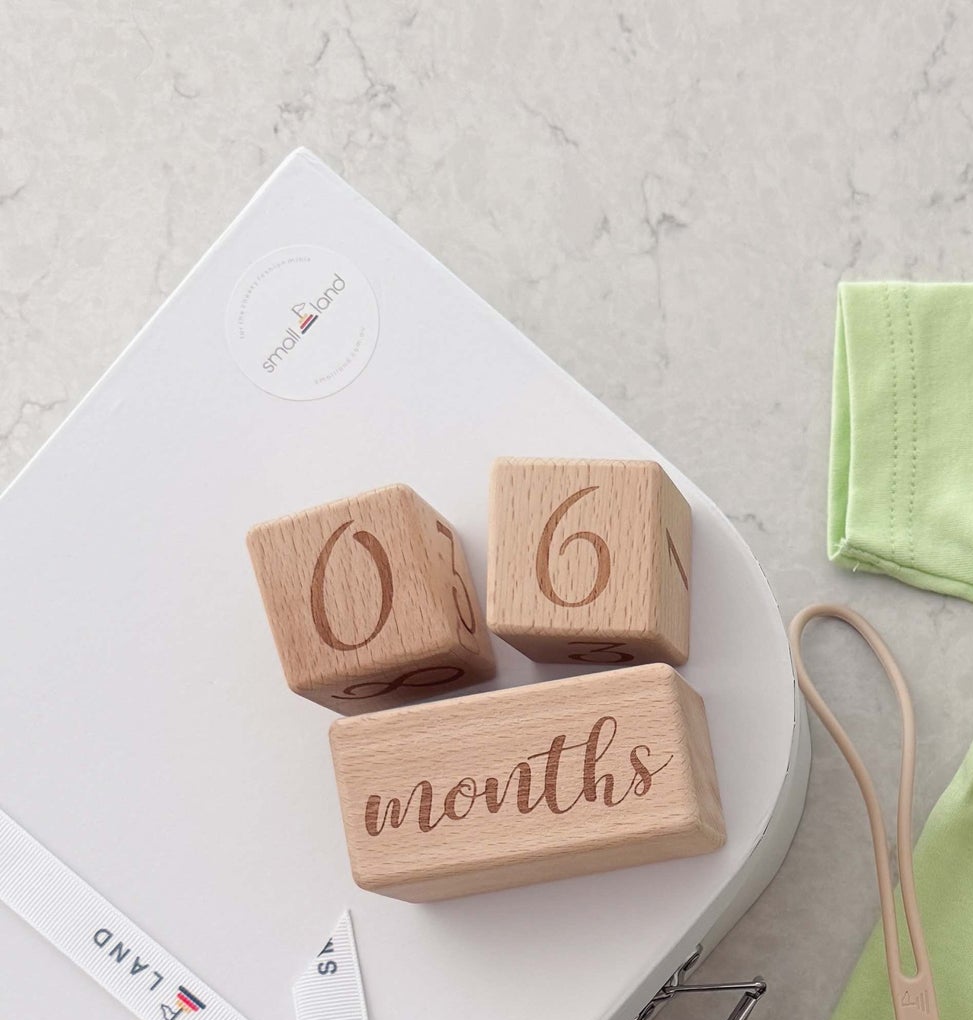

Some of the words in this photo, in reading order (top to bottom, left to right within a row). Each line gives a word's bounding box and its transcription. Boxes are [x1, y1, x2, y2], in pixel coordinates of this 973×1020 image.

[262, 327, 301, 373] small
[309, 273, 346, 313] land
[311, 519, 394, 651] 0
[535, 486, 612, 608] 6
[364, 716, 674, 837] months
[93, 928, 165, 991] LAND
